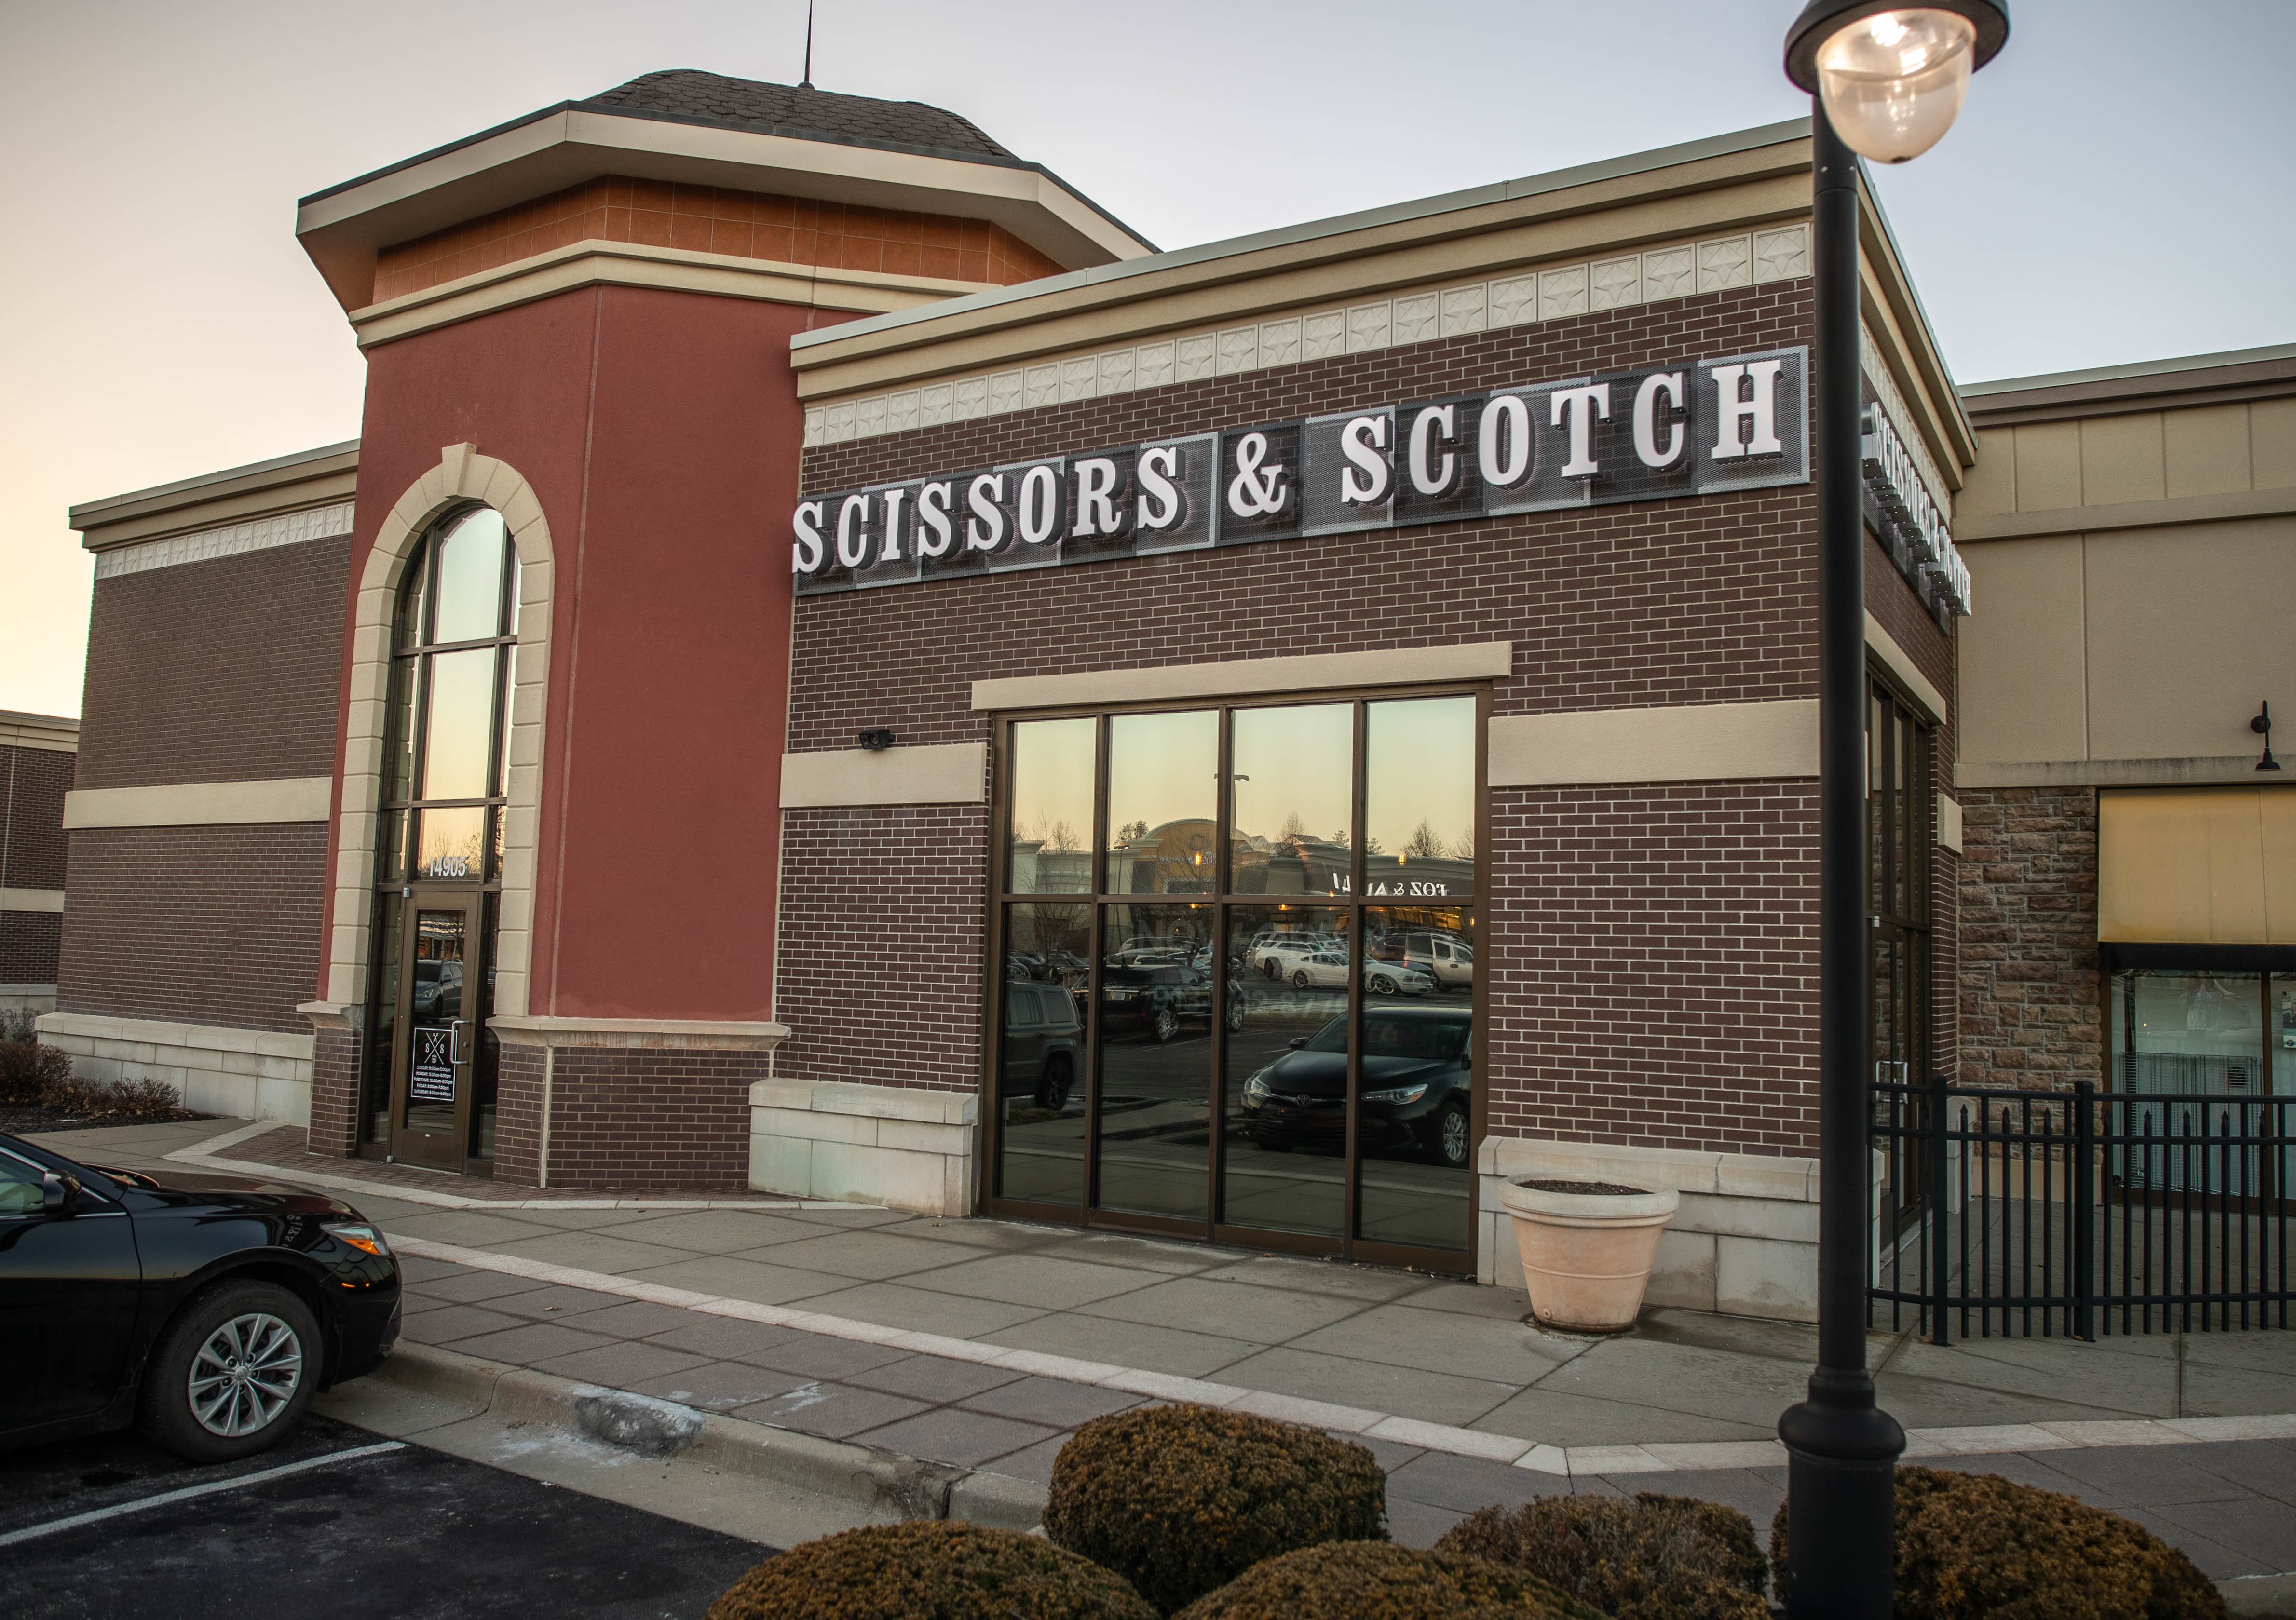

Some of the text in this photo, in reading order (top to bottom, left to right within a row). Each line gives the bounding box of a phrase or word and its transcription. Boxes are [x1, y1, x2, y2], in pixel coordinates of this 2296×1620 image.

[792, 359, 1782, 574] SCISSORS & SCOTCH
[429, 856, 466, 876] 14905
[425, 1043, 444, 1054] S S
